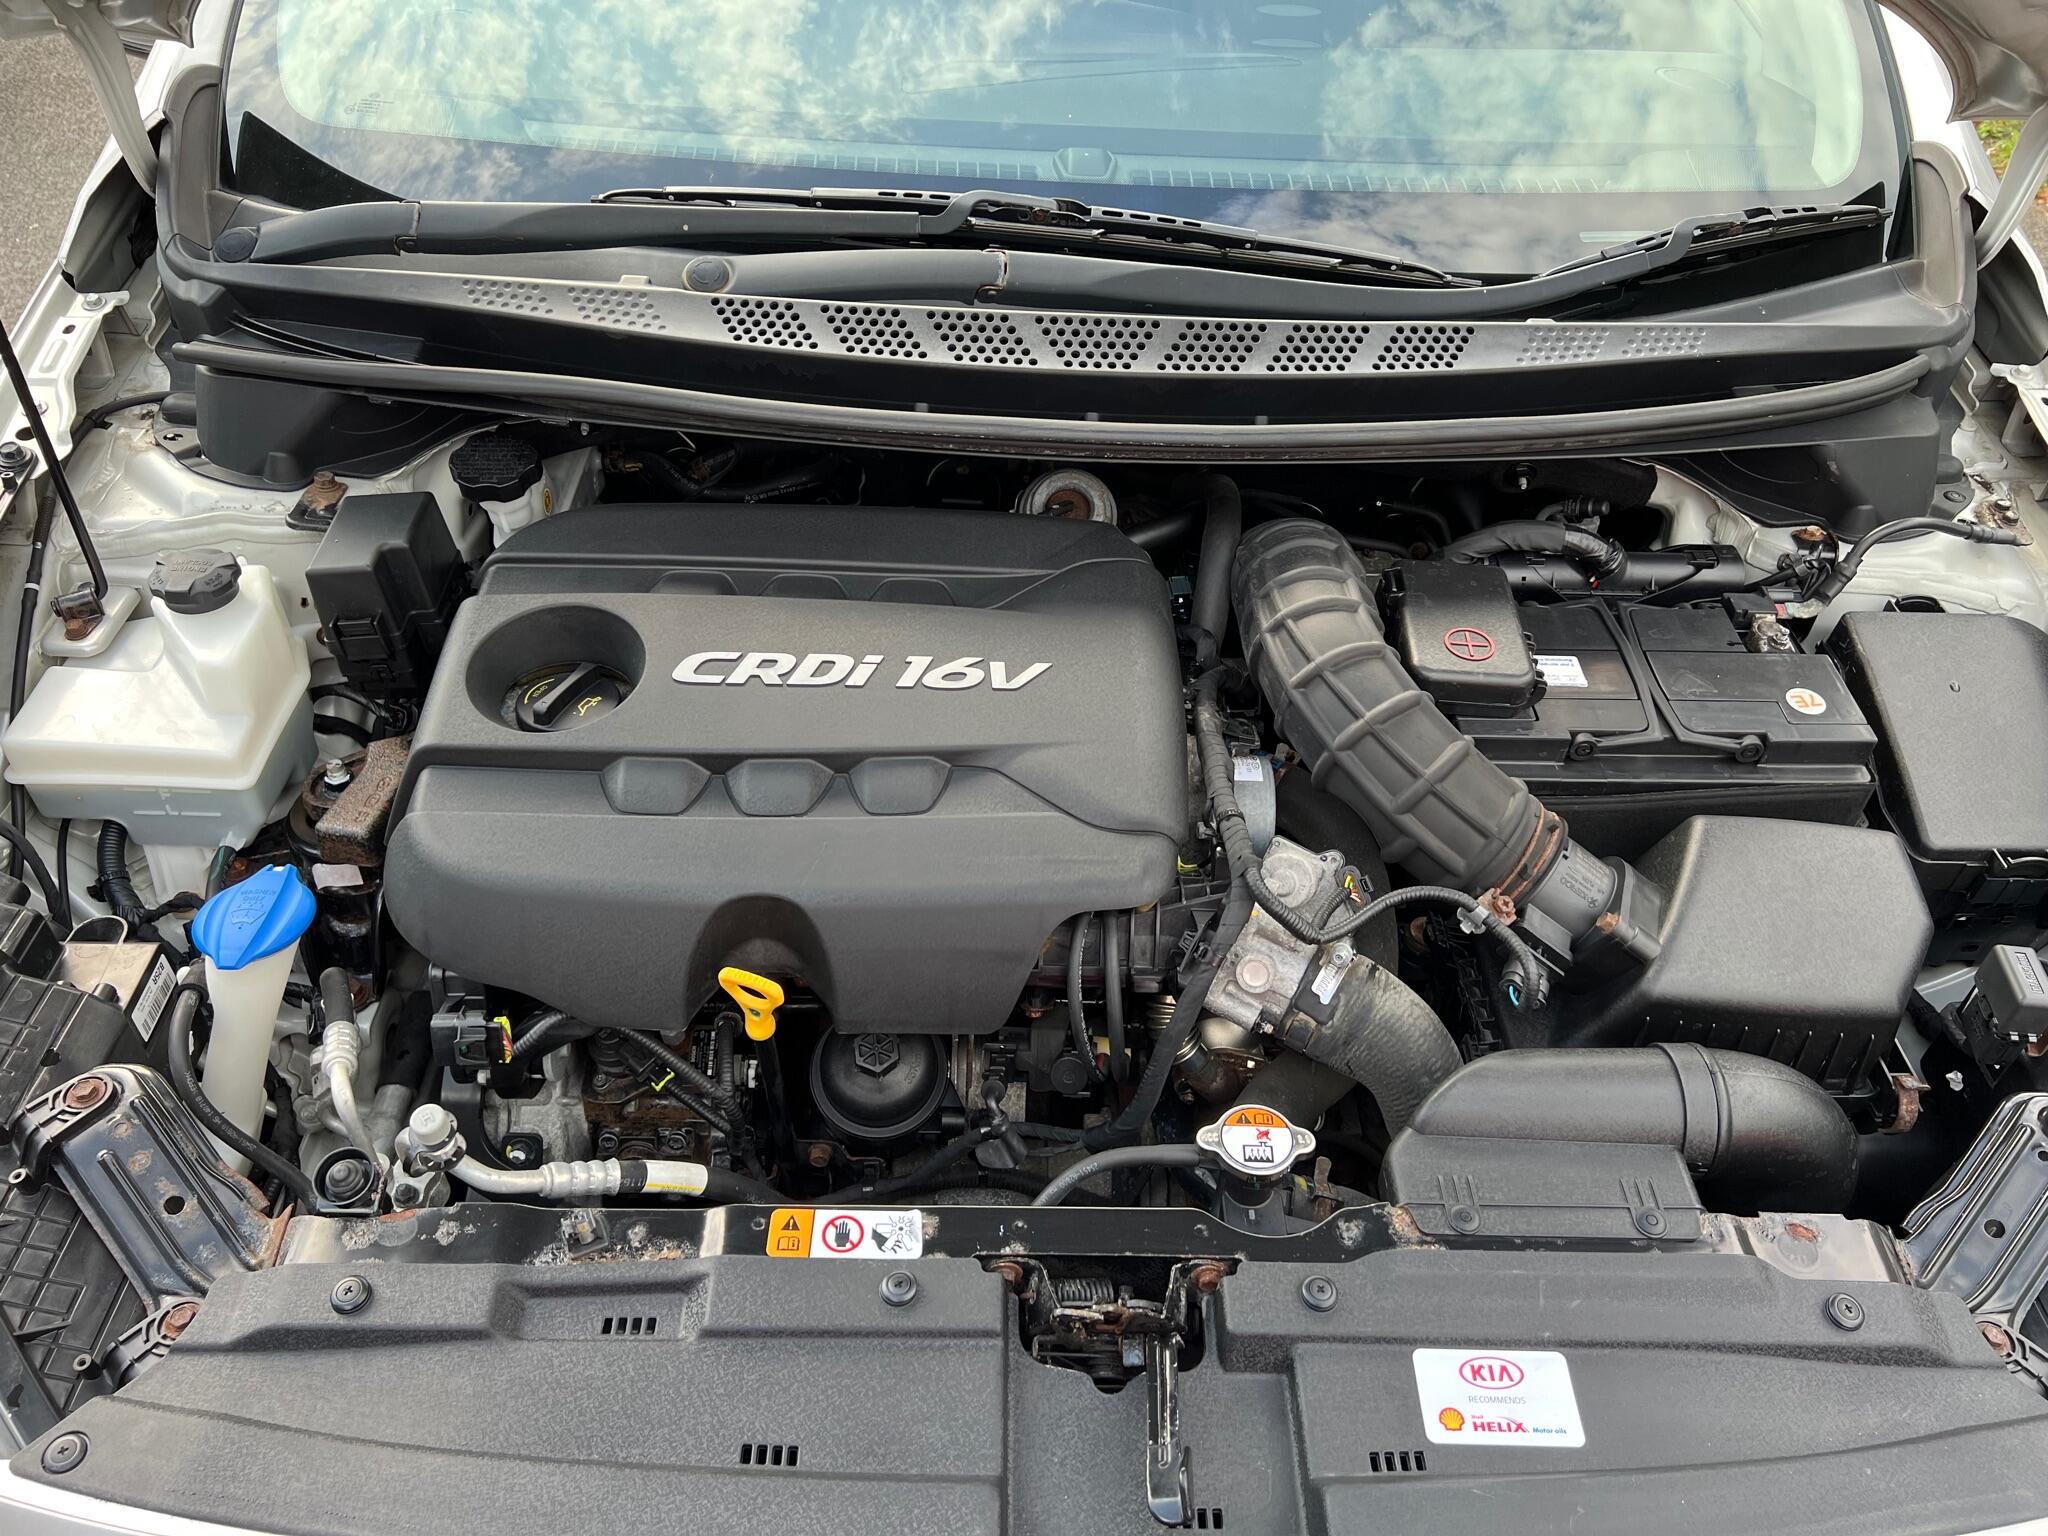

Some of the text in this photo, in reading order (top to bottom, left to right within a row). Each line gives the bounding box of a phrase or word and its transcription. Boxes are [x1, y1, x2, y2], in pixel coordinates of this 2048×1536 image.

[671, 652, 1053, 691] CRDi 16V
[1790, 694, 1823, 708] 7E
[1468, 1364, 1515, 1382] KIA
[1468, 1395, 1526, 1405] RECOMMENDS
[1472, 1421, 1529, 1433] HELIX
[1554, 1427, 1567, 1435] oils
